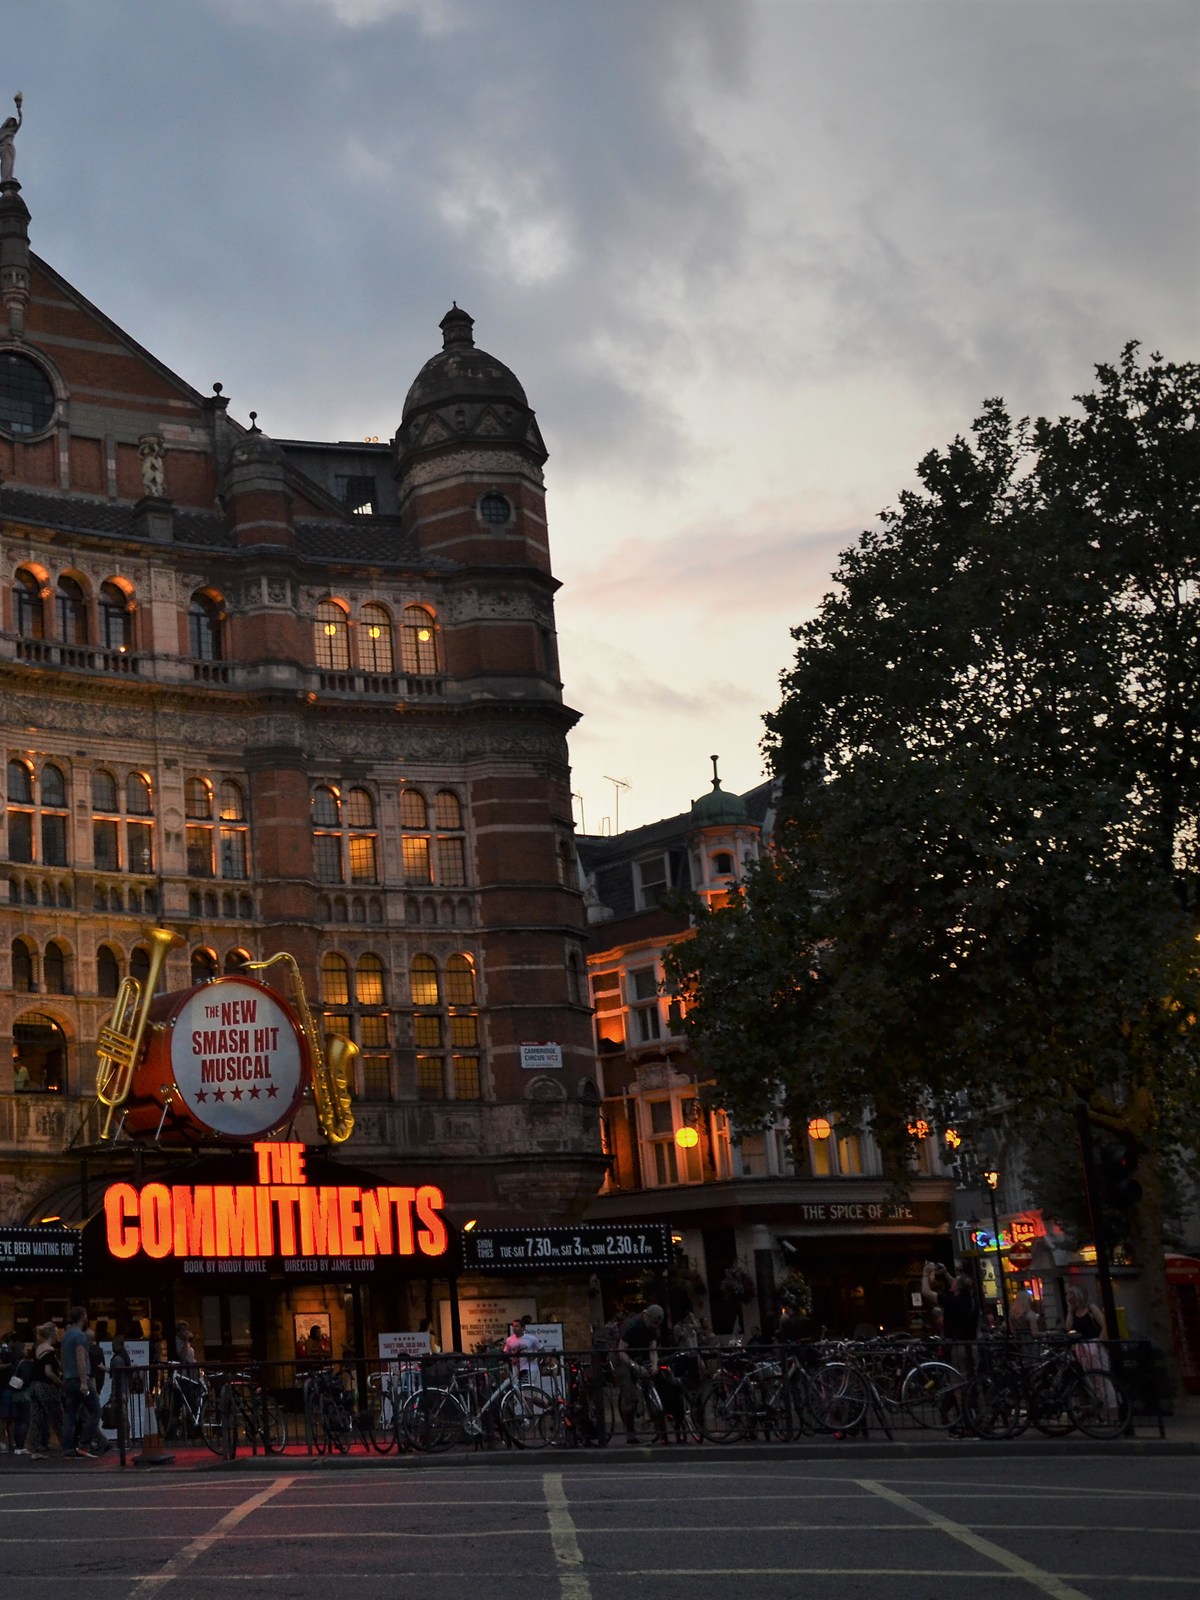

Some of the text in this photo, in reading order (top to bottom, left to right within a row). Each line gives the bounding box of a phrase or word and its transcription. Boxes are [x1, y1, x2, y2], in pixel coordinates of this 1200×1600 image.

[205, 1000, 257, 1026] THE NEW
[192, 1027, 279, 1055] SMASH HIT
[201, 1055, 272, 1083] MUSICAL
[254, 1142, 308, 1184] THE
[104, 1182, 448, 1259] COMMITMENTS
[801, 1205, 826, 1219] THE
[830, 1204, 864, 1219] SPICE
[867, 1204, 884, 1218] OF
[14, 1241, 31, 1255] BEEN
[33, 1242, 59, 1256] WAITING
[476, 1239, 493, 1249] SHOW
[500, 1246, 525, 1258] TUE-SAT
[561, 1245, 573, 1256] SAT
[591, 1244, 605, 1255] SUN
[606, 1235, 631, 1254] 2.30
[477, 1249, 494, 1259] TIMES
[183, 1260, 267, 1273] BOOK BY RODDY DOYLE
[284, 1258, 375, 1272] DIRECTED BY JAMIE LLOYD
